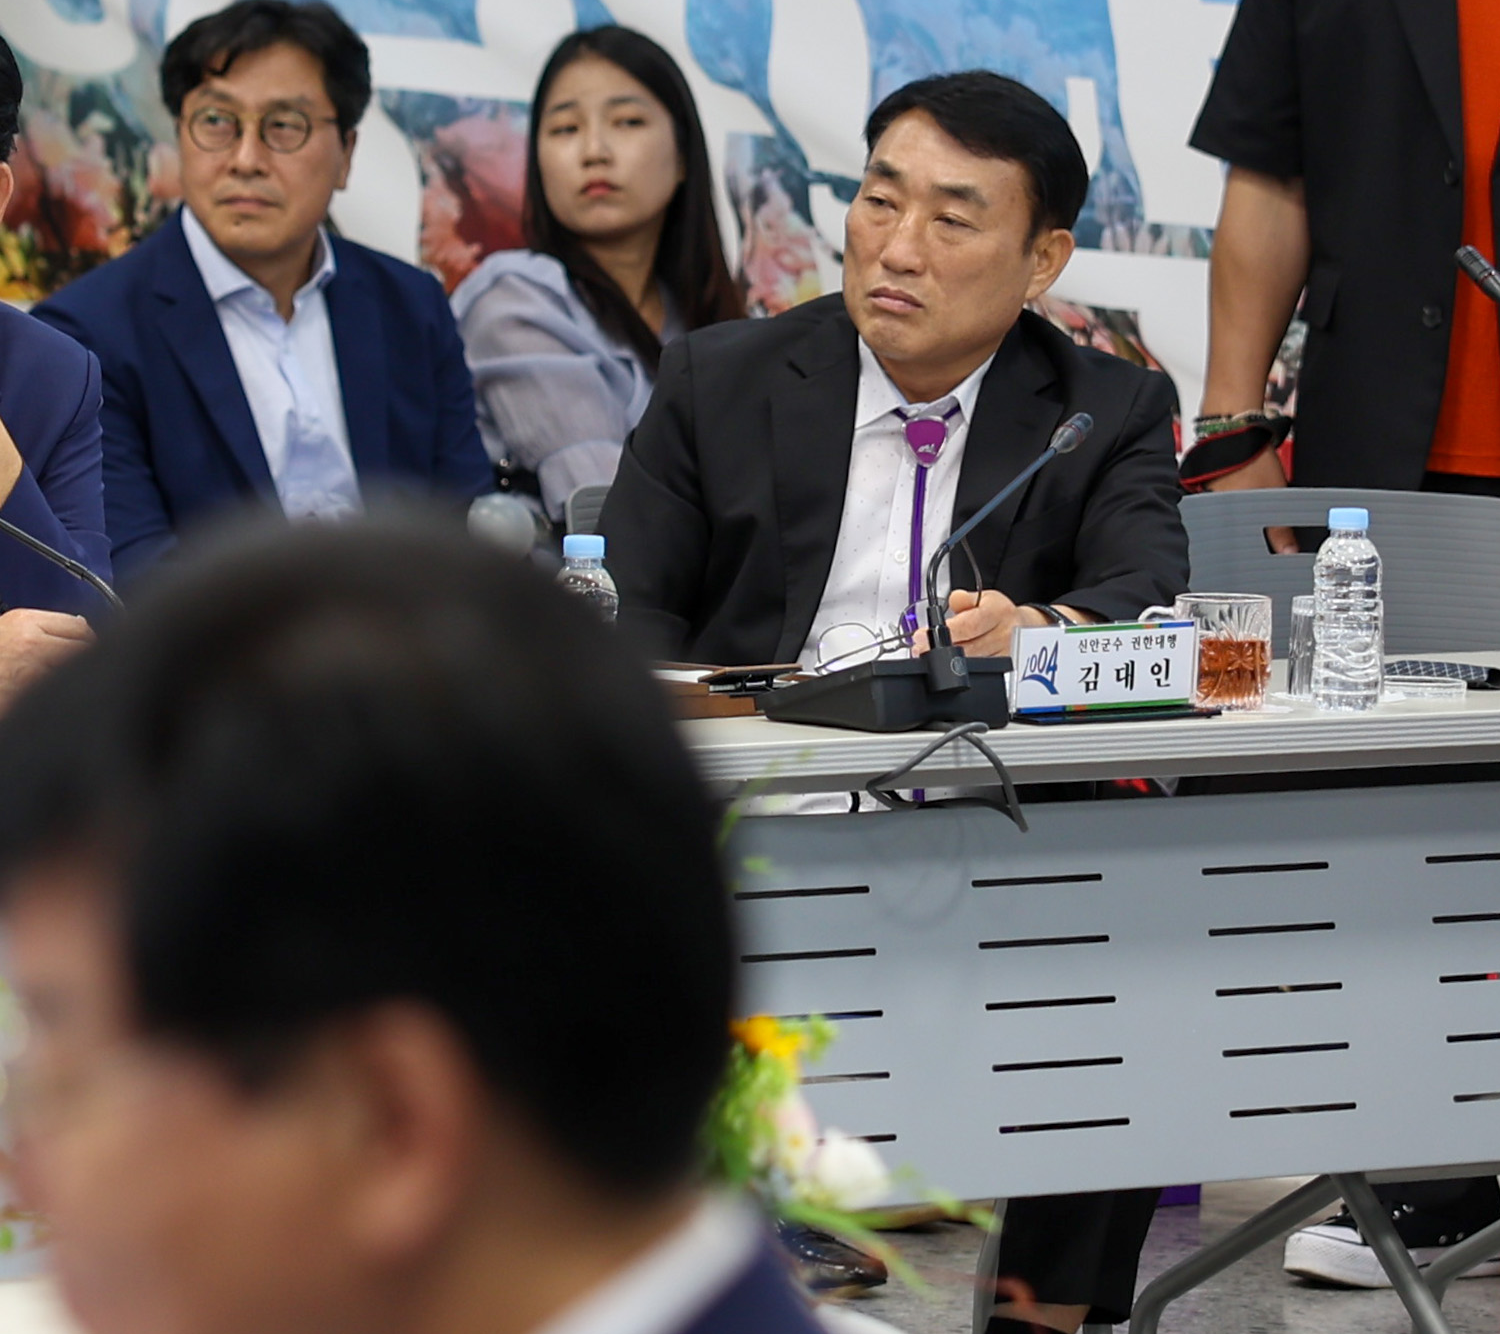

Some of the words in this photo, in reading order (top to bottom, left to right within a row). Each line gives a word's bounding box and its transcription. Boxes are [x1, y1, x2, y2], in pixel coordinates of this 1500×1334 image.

[1078, 636, 1123, 654] 신안군수
[1130, 633, 1178, 652] 권한대행
[1078, 657, 1172, 694] 김대인
